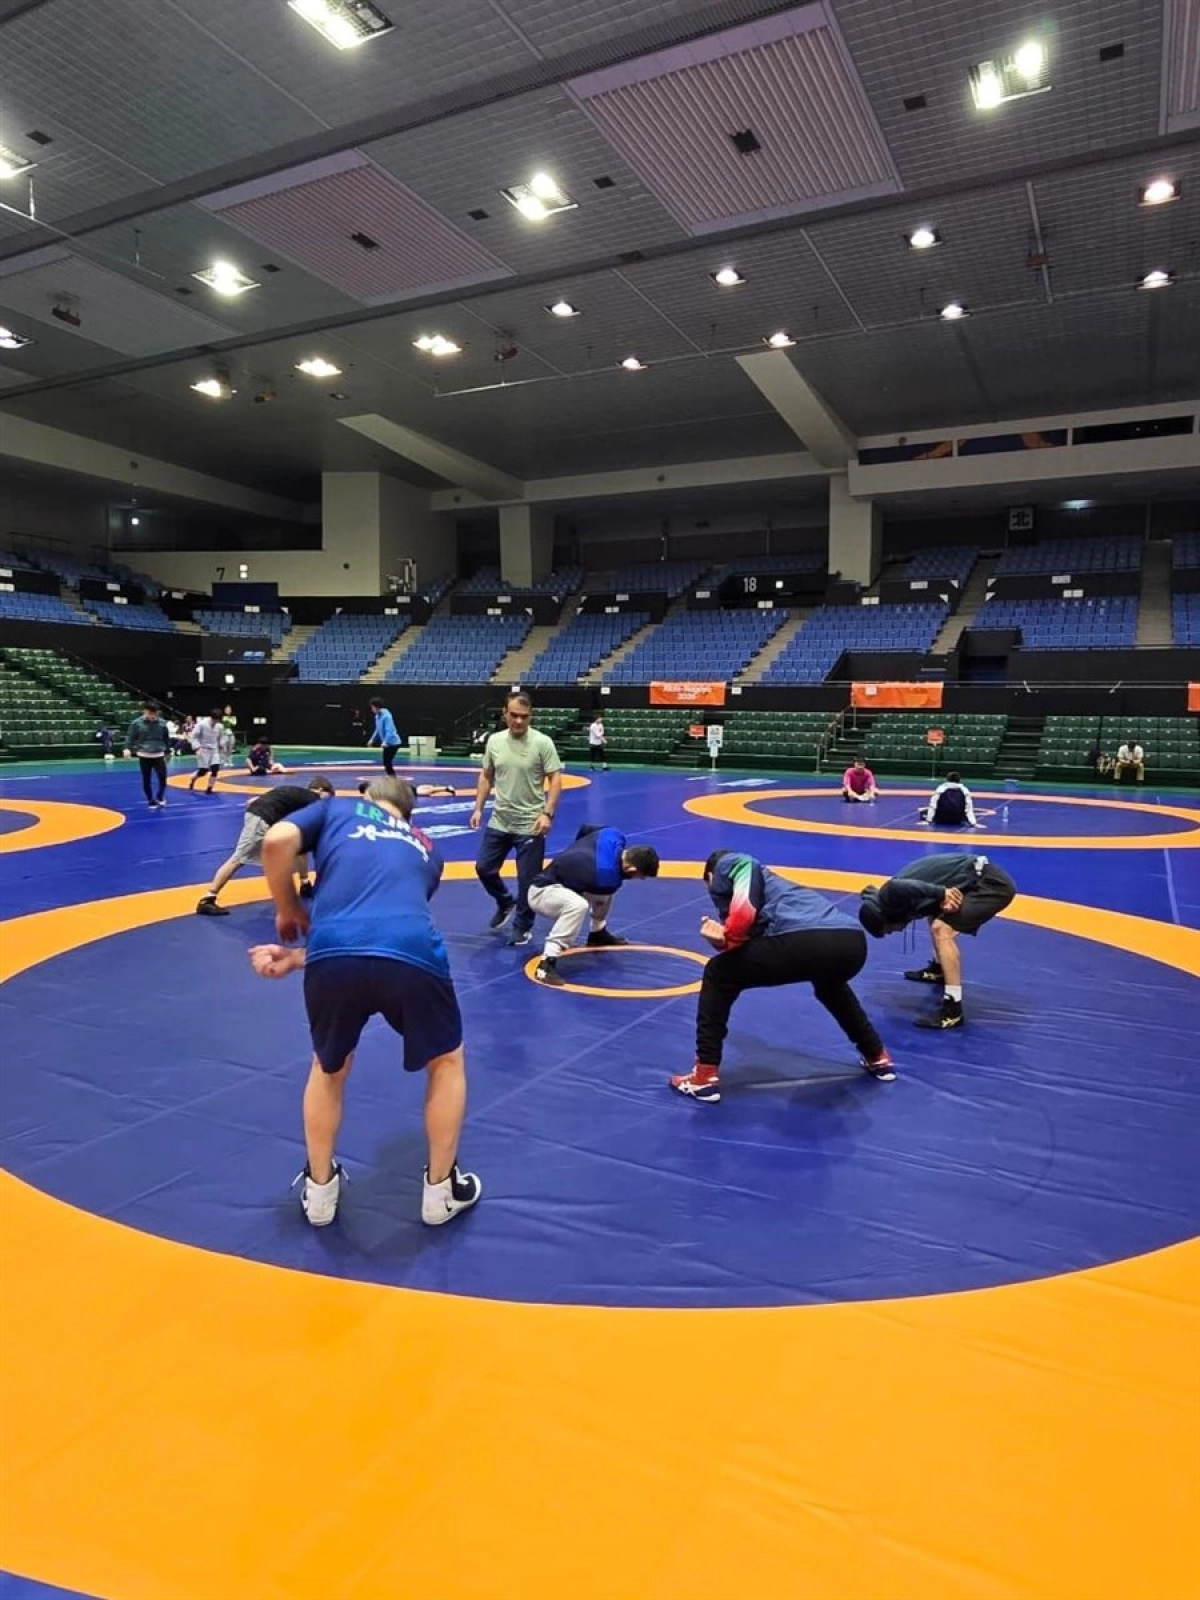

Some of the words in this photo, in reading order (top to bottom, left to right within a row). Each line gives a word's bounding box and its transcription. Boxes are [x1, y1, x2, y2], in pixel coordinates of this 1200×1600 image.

[215, 567, 225, 581] 7
[743, 576, 757, 593] 18
[195, 665, 205, 683] 1
